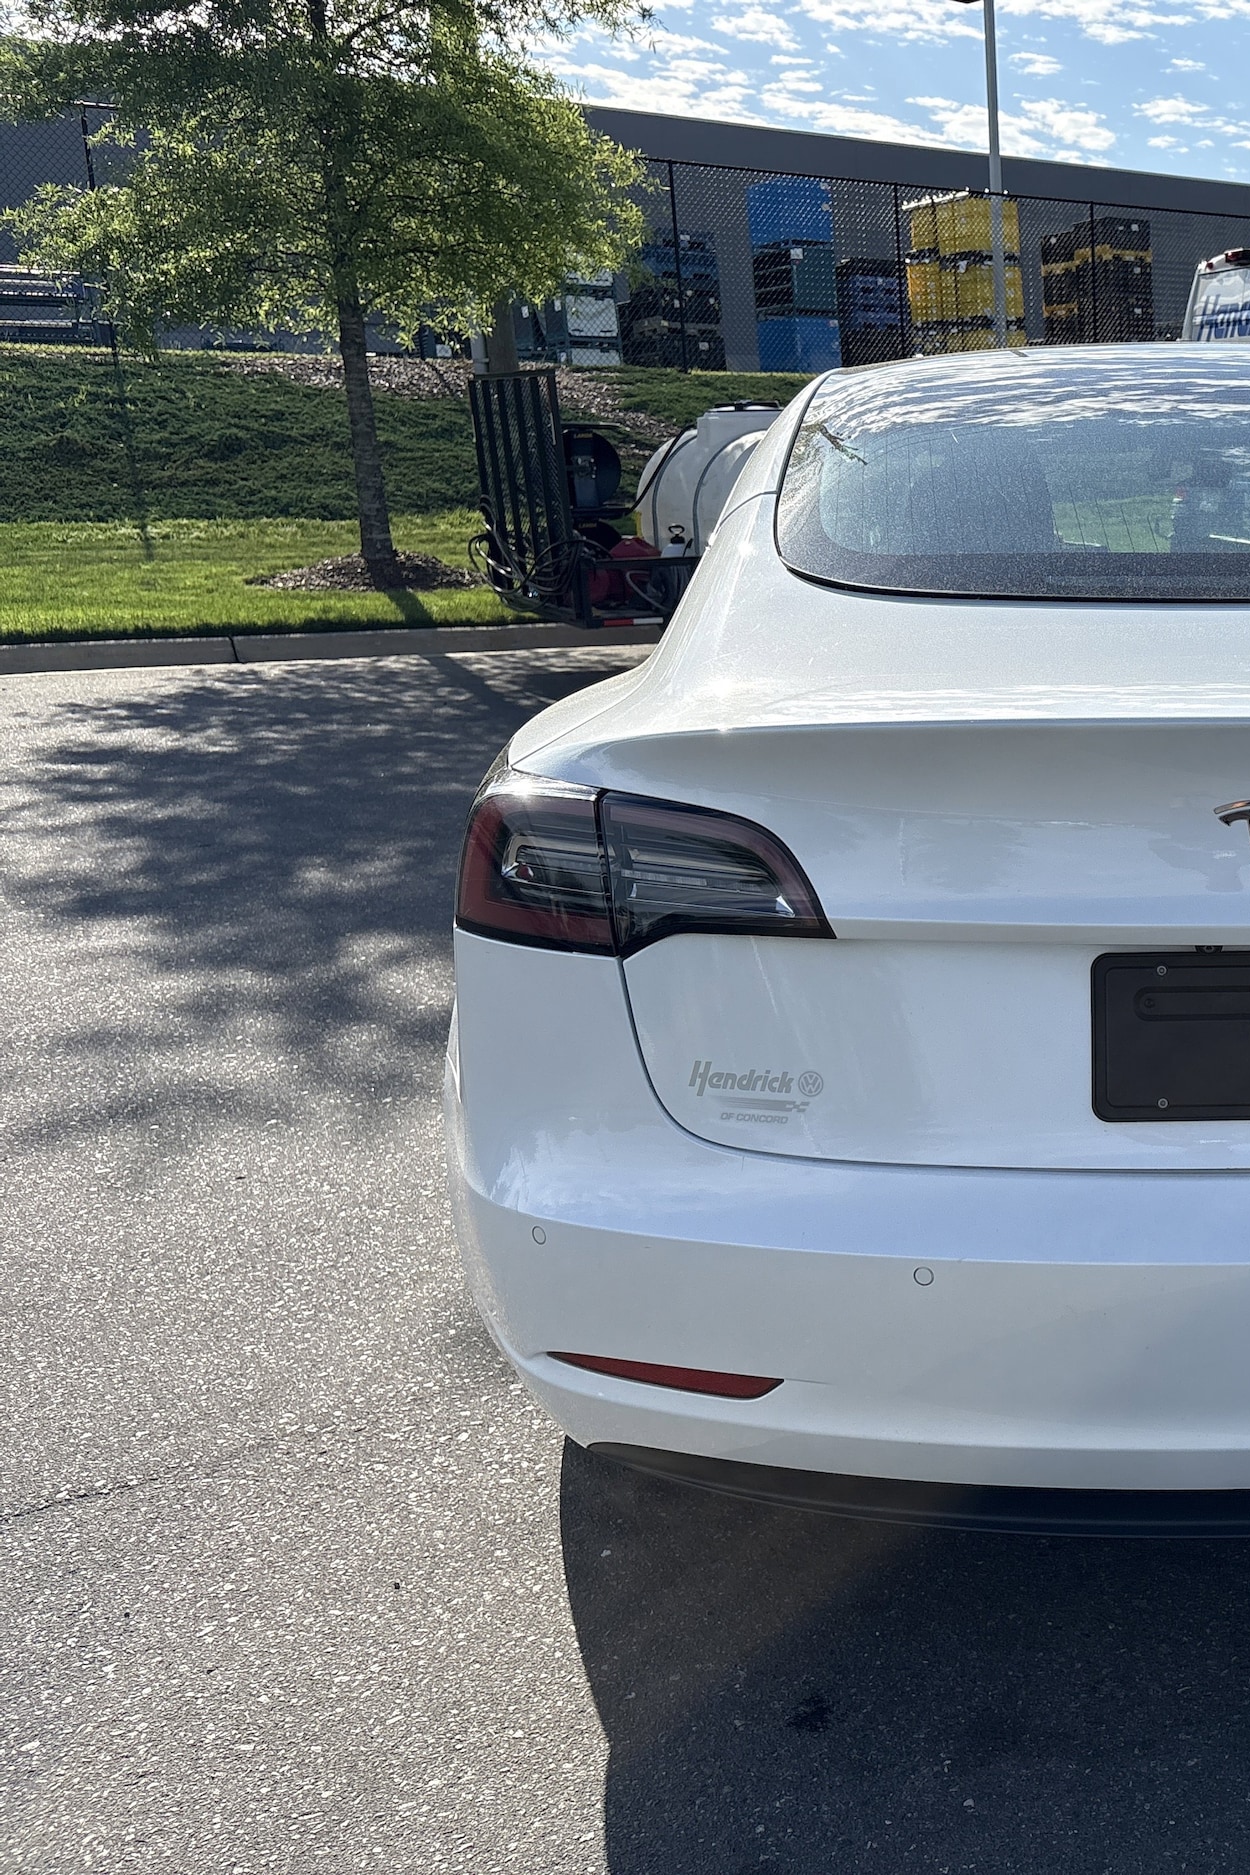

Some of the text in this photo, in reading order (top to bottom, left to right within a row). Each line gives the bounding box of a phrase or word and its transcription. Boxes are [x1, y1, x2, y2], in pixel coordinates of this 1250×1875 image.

[688, 1060, 795, 1097] Hendrick
[720, 1112, 789, 1125] OF CONCORD
